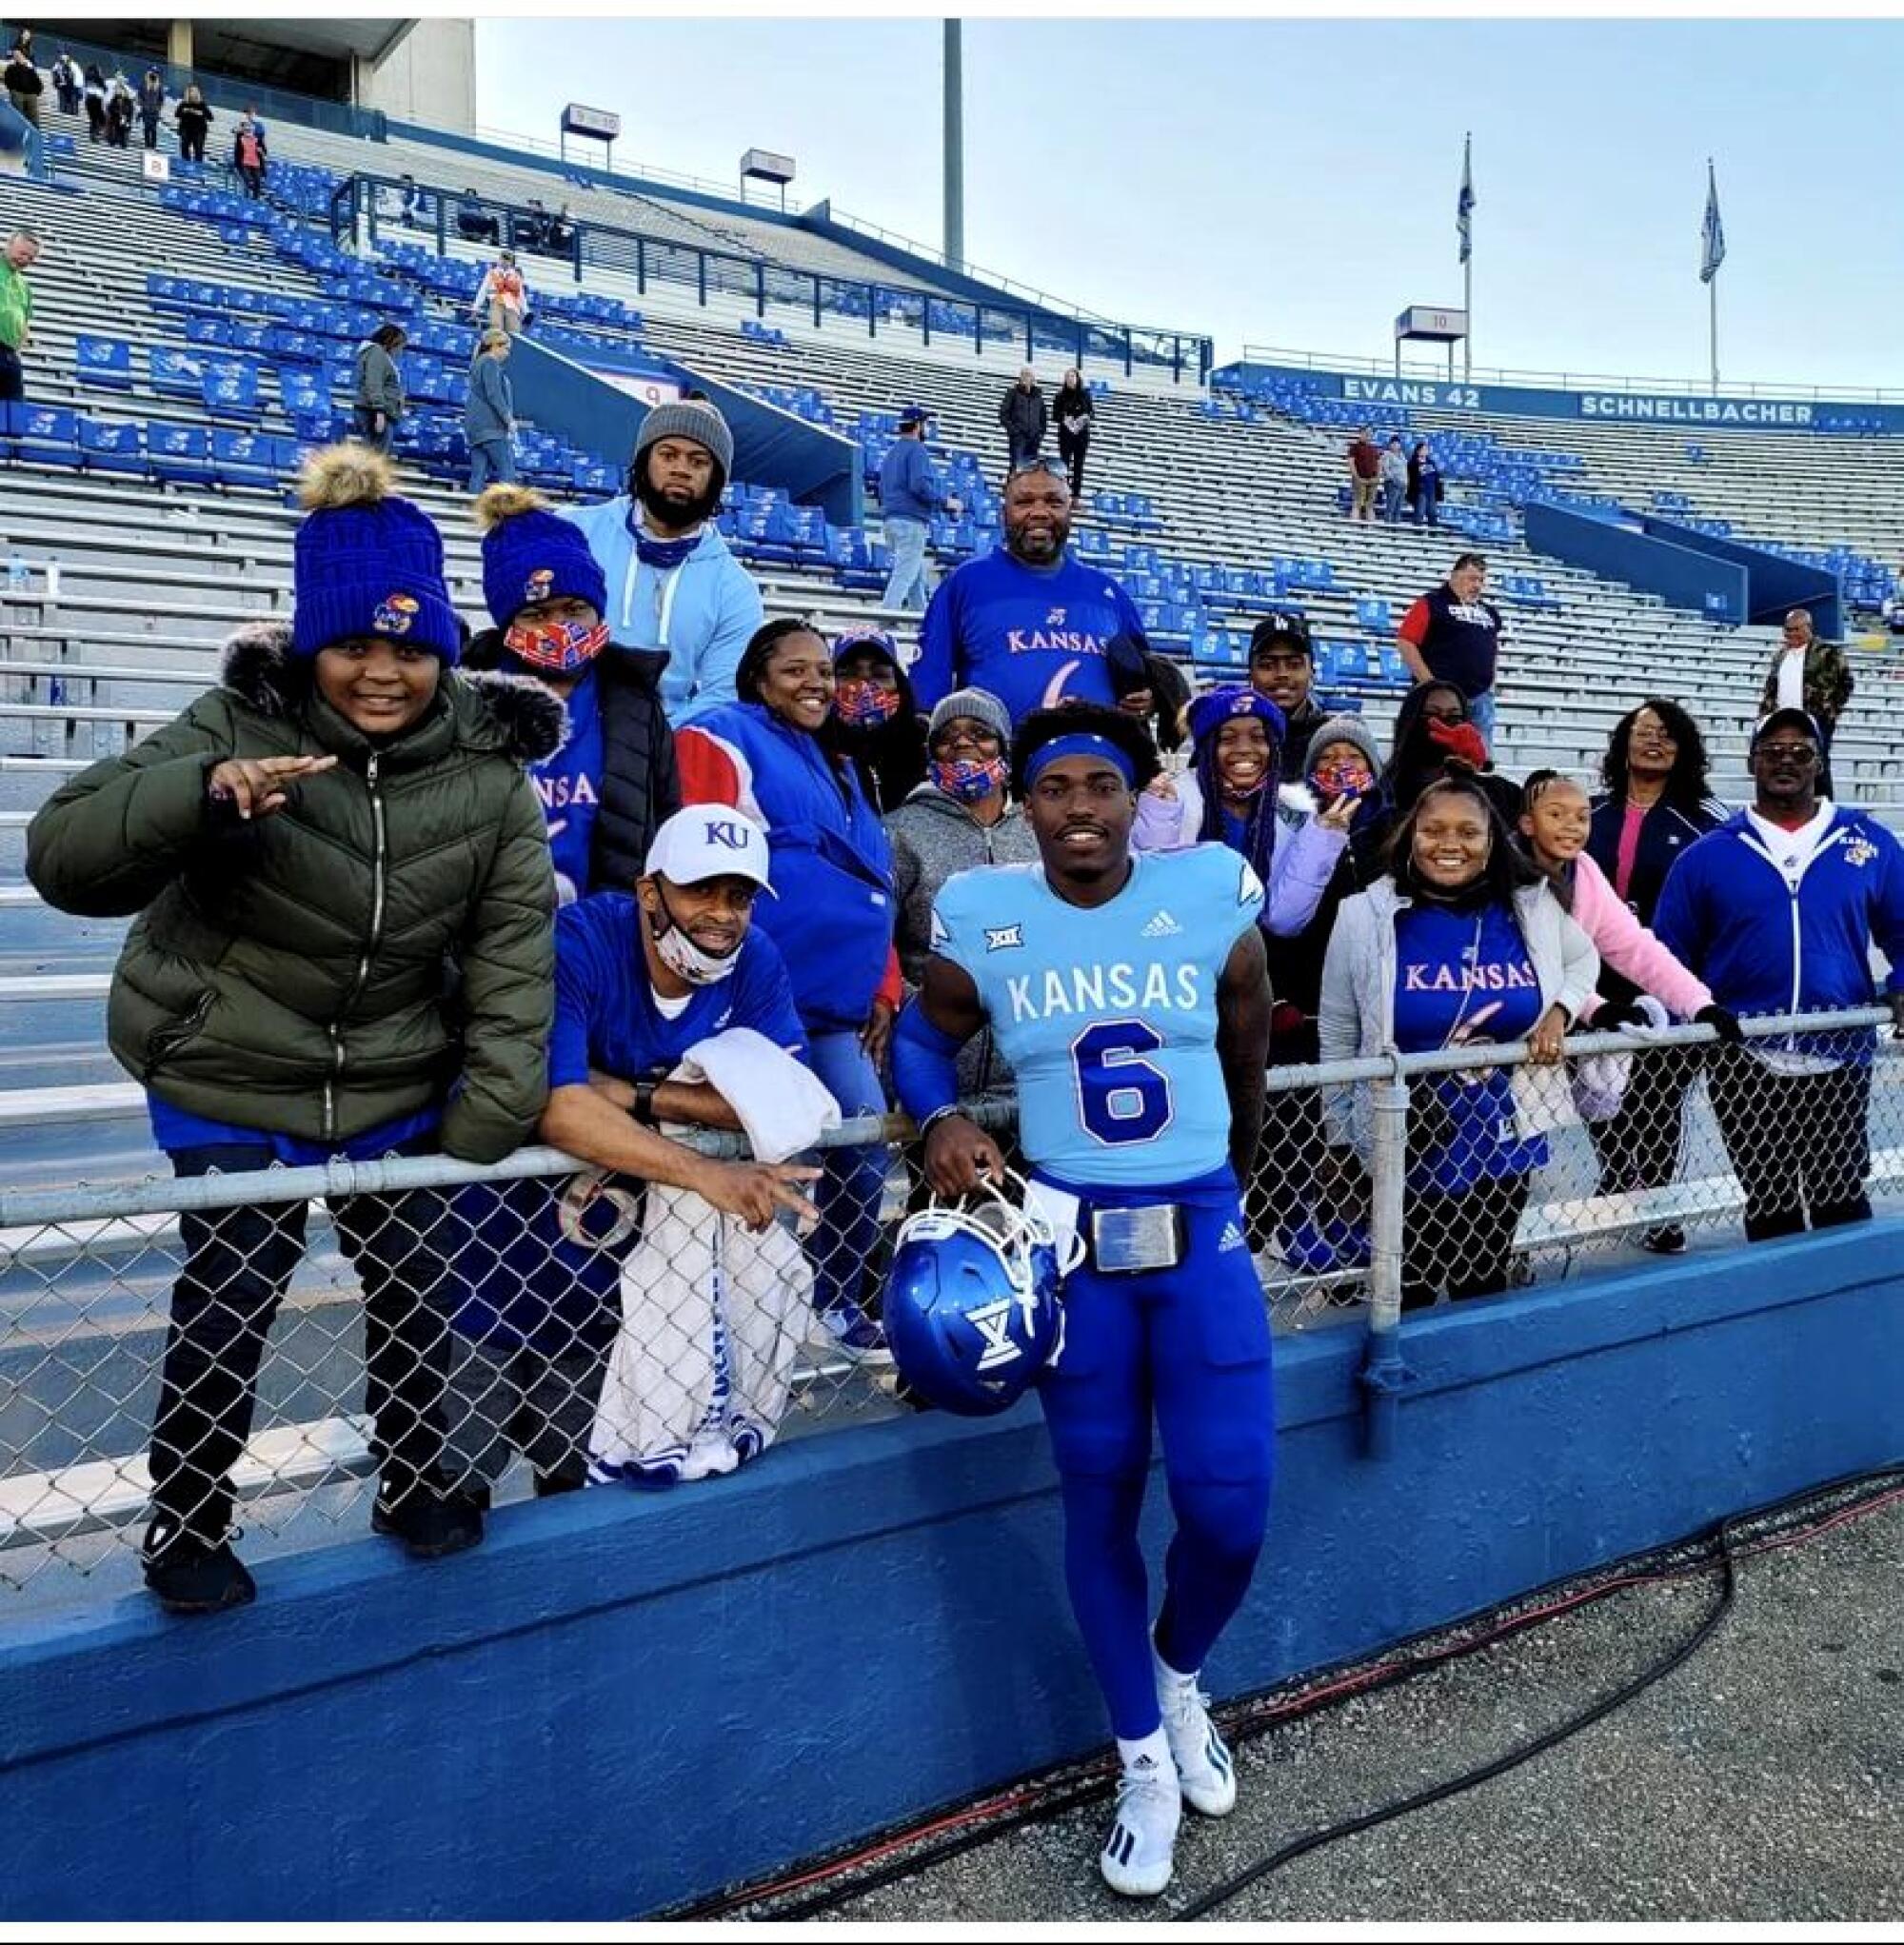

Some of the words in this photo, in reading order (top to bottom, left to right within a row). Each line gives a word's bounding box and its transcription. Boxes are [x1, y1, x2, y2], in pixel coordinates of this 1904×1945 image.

[1434, 314, 1448, 328] 10
[645, 386, 661, 406] 9
[1343, 378, 1436, 405] EVANS
[1445, 387, 1480, 408] 42
[1580, 395, 1812, 424] SCHNELLBACHER
[704, 820, 750, 850] KU
[1005, 963, 1200, 1022] KANSAS
[1070, 1017, 1175, 1148] 6
